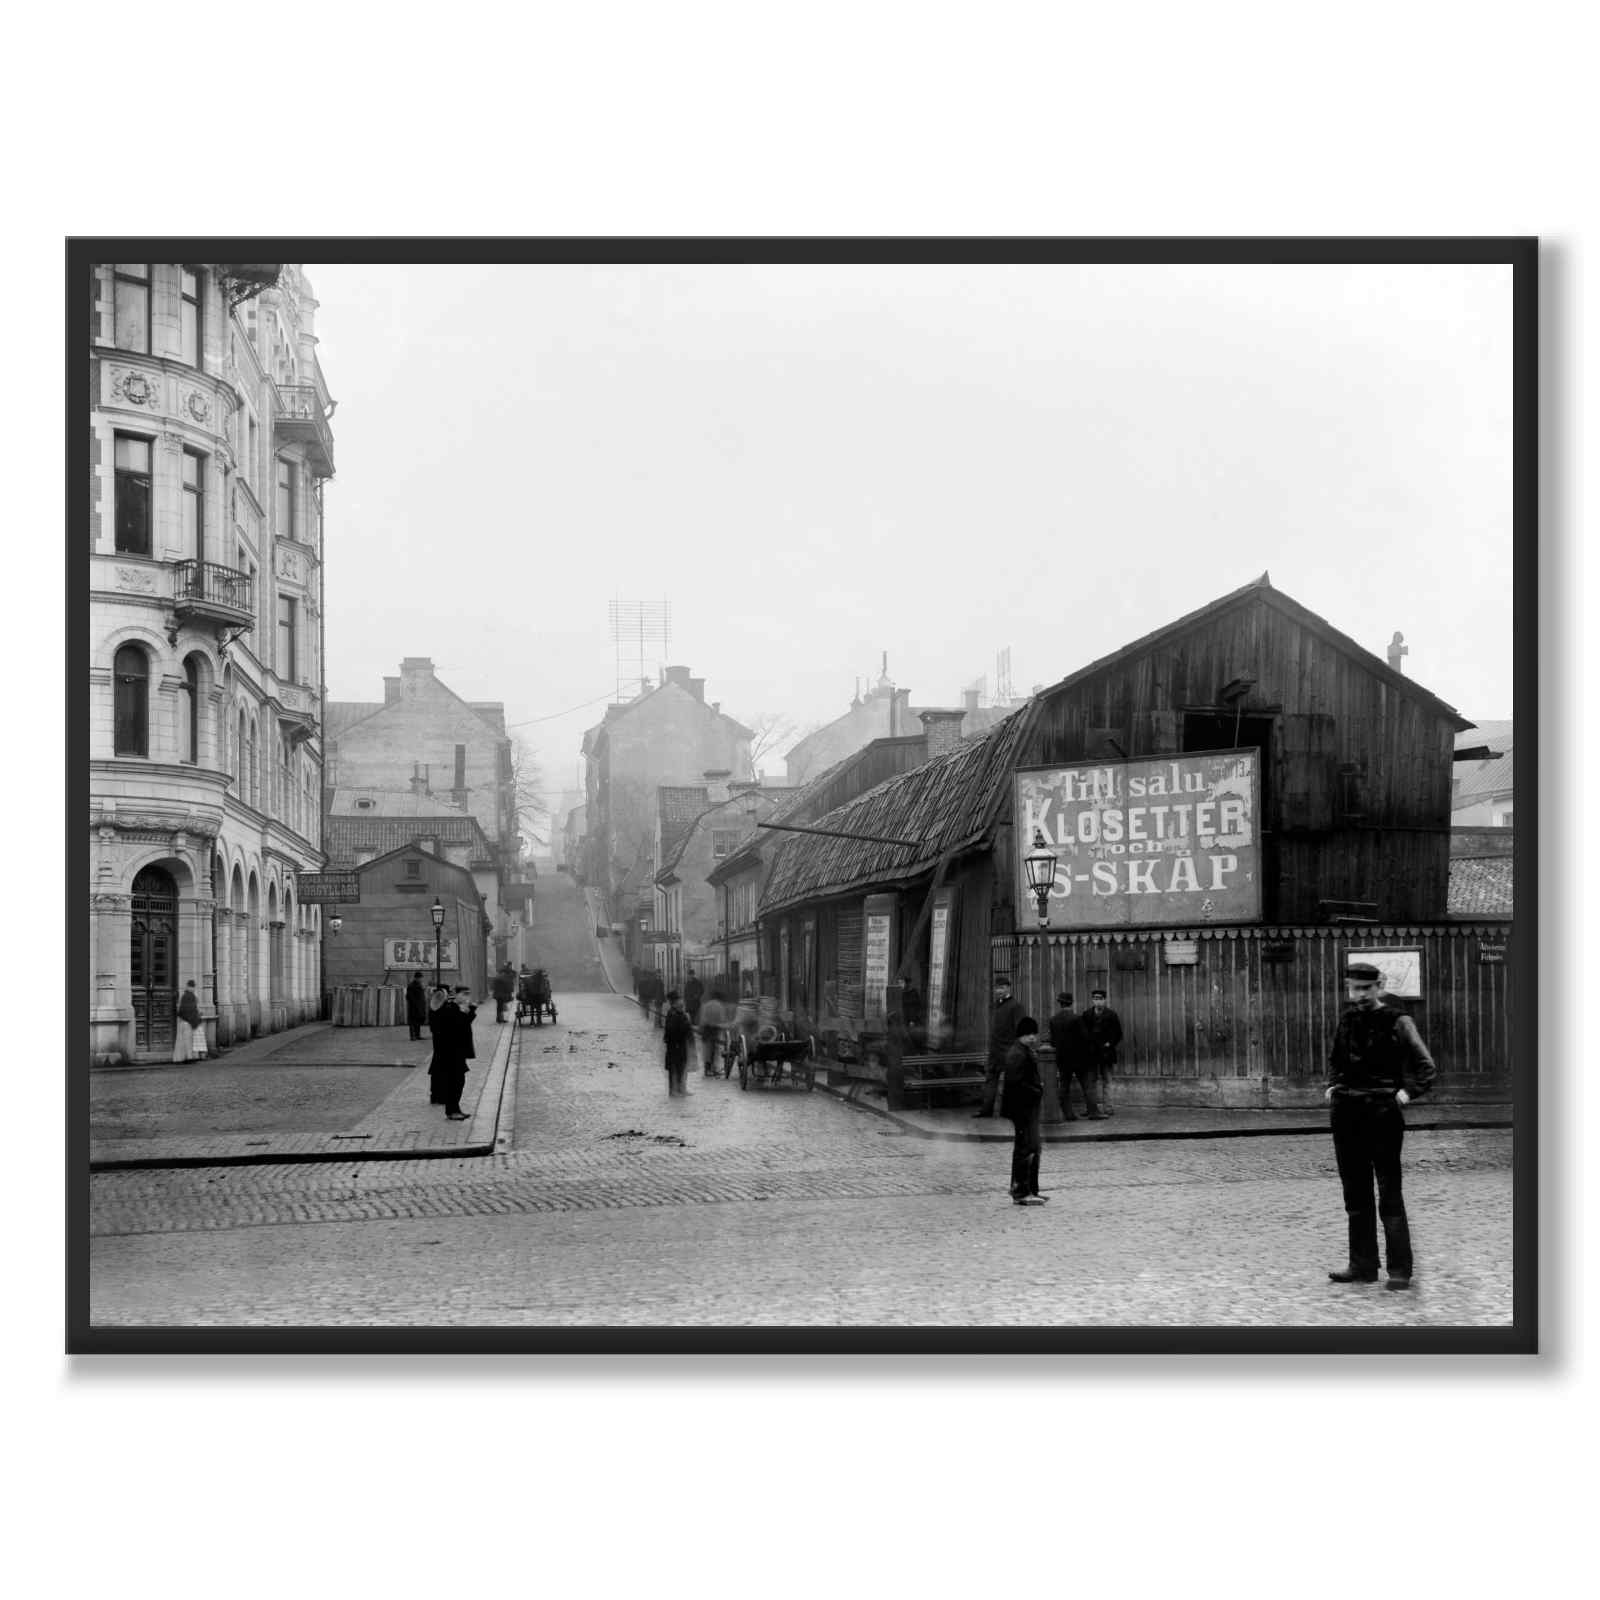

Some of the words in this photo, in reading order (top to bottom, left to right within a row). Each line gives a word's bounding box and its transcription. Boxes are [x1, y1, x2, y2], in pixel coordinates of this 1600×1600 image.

[1059, 768, 1118, 801] Till
[1110, 839, 1163, 854] och
[1028, 850, 1238, 898] S-SKÅP
